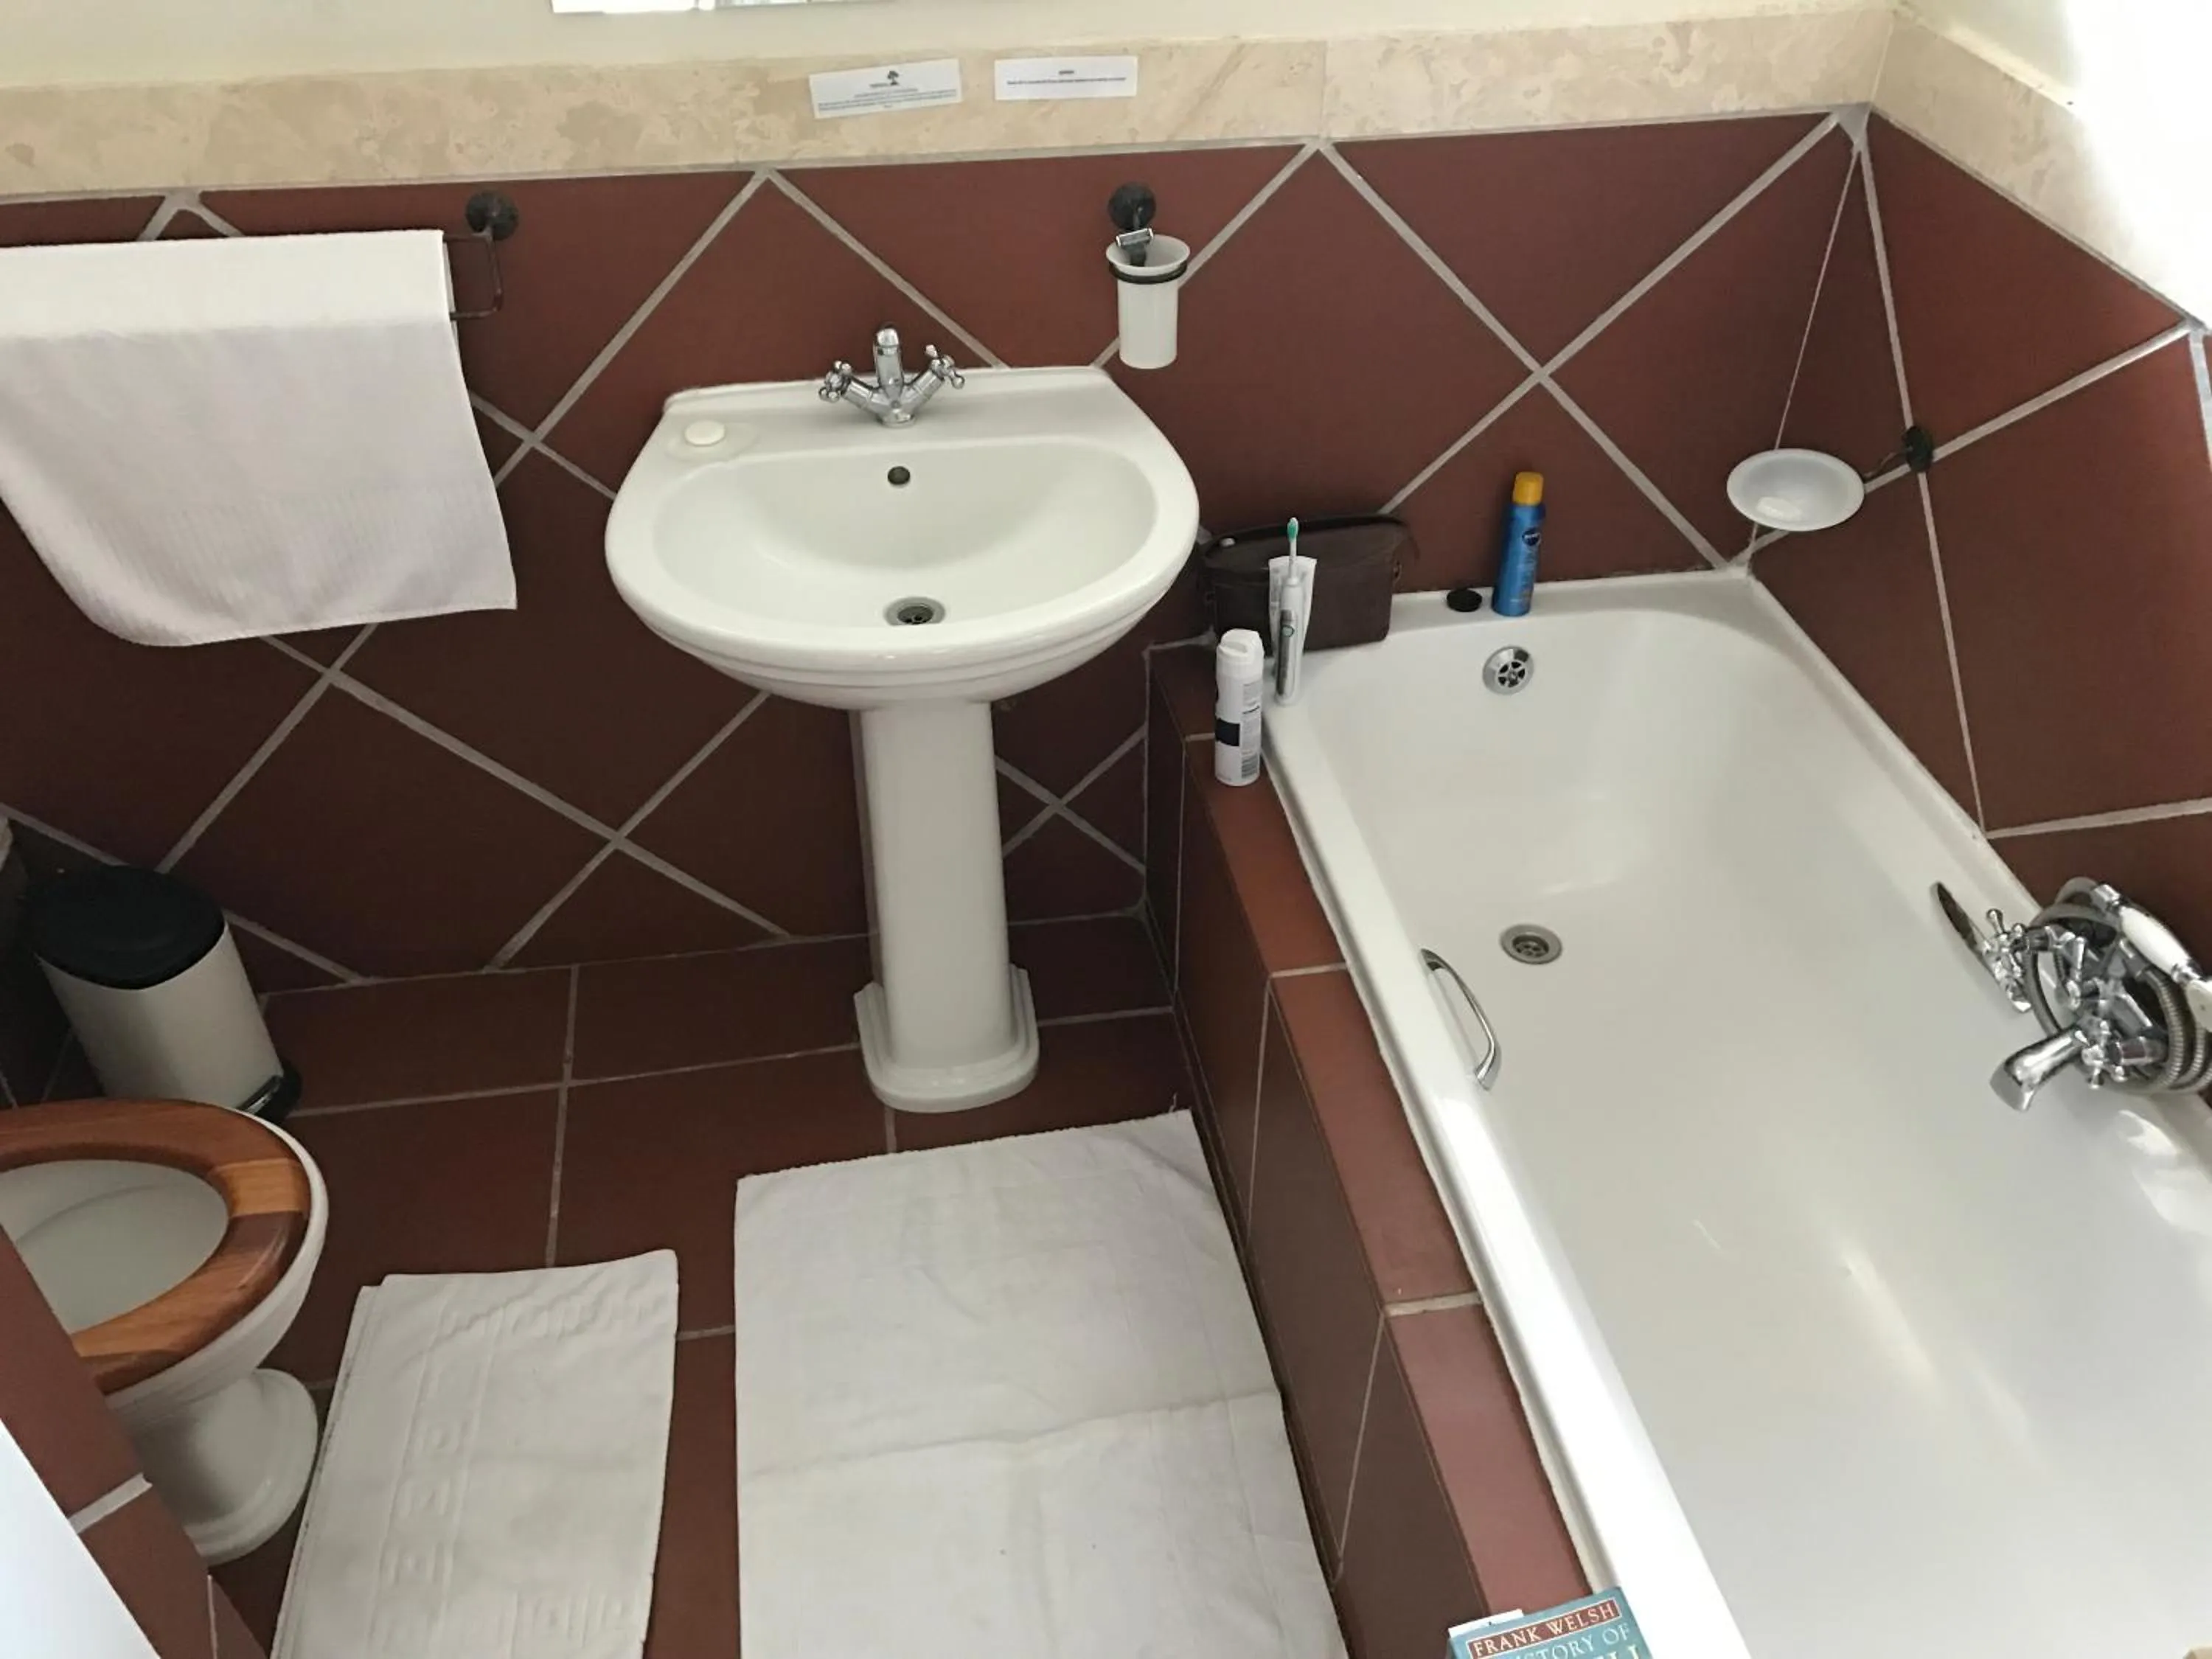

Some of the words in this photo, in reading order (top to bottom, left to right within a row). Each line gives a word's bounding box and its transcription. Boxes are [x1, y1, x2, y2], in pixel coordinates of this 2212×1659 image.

[1473, 1627, 1543, 1658] FRANK
[1545, 1602, 1615, 1635] WELSH
[1601, 1622, 1630, 1646] OF
